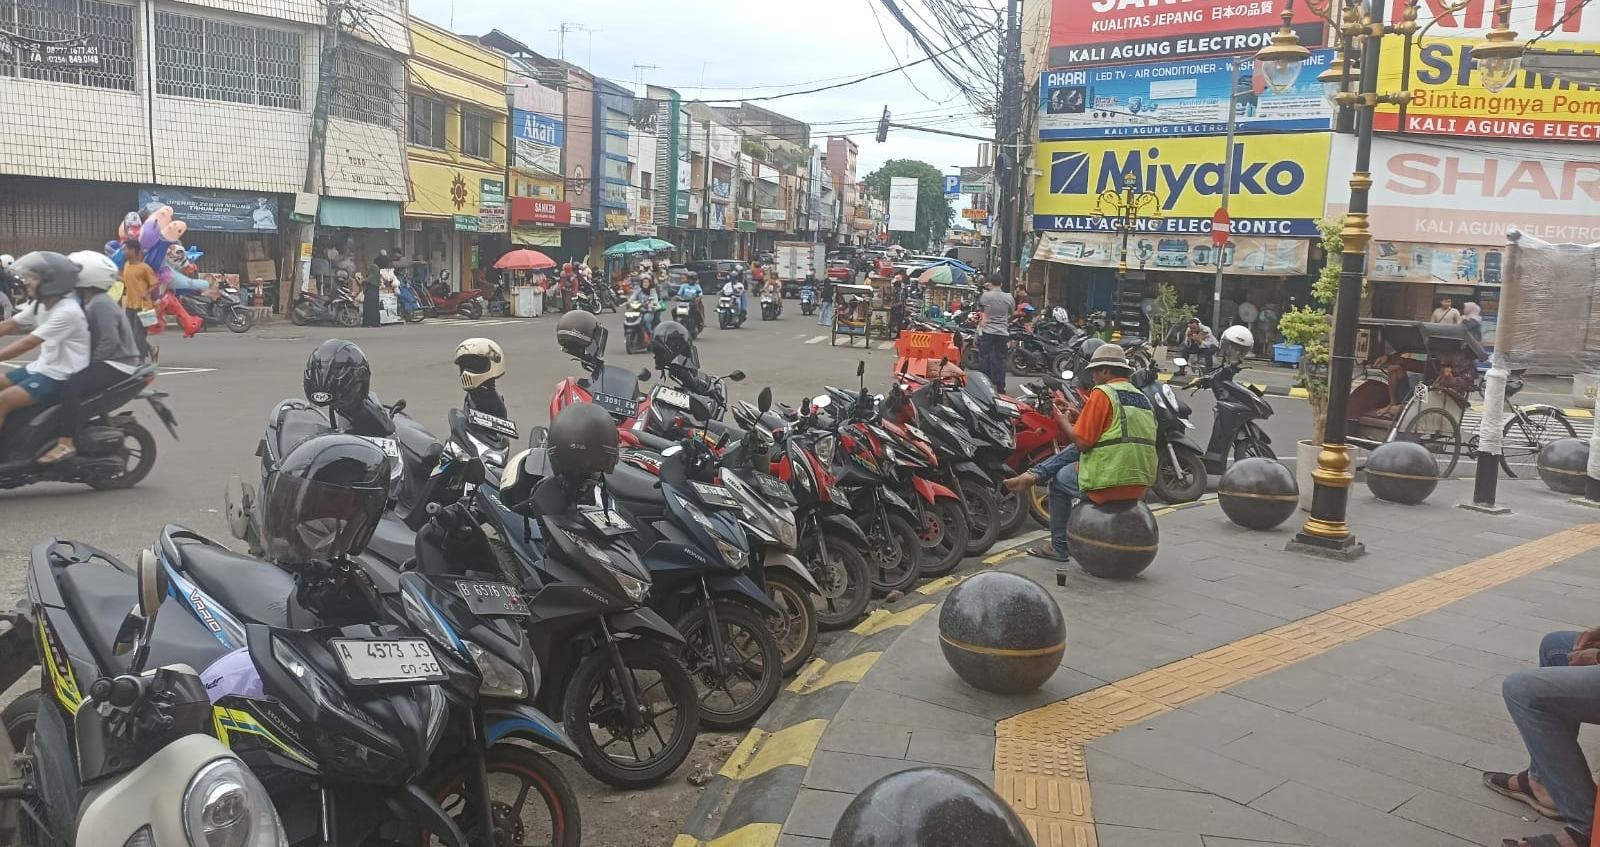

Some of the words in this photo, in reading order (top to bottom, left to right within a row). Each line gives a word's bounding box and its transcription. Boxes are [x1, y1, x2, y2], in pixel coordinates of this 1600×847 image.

[1211, 1, 1273, 20] 日本の品質
[1091, 13, 1150, 33] KUALITAS
[1152, 9, 1203, 26] JEPANG
[1068, 47, 1104, 63] KALI
[1110, 41, 1170, 60] AGUNG
[1176, 29, 1297, 53] ELECTRON
[1047, 71, 1086, 86] AKARI
[1095, 72, 1113, 81] LED
[1114, 70, 1127, 80] TV
[1134, 68, 1150, 78] AIR
[1151, 63, 1216, 77] CONDITIONER
[1411, 88, 1544, 116] Bintangnya
[523, 115, 555, 143] Akari
[1104, 127, 1128, 135] KALI
[1132, 126, 1168, 134] AGUNG
[1409, 117, 1457, 132] KALI
[1464, 120, 1535, 136] AGUNG
[946, 176, 958, 195] P
[1095, 142, 1305, 210] Miyako
[1385, 152, 1600, 202] SHAR
[534, 202, 556, 213] SANKEN
[1054, 216, 1092, 229] KALI
[1167, 218, 1292, 234] ELECRONIC
[1415, 218, 1454, 234] KALI
[683, 546, 707, 564] HONDA
[460, 583, 470, 596] B
[473, 584, 500, 597] 6576
[582, 586, 609, 605] HONDA
[188, 587, 223, 633] VARIO
[340, 643, 353, 659] A
[367, 642, 405, 658] 4573
[410, 642, 430, 658] IS
[266, 708, 301, 740] HONDA
